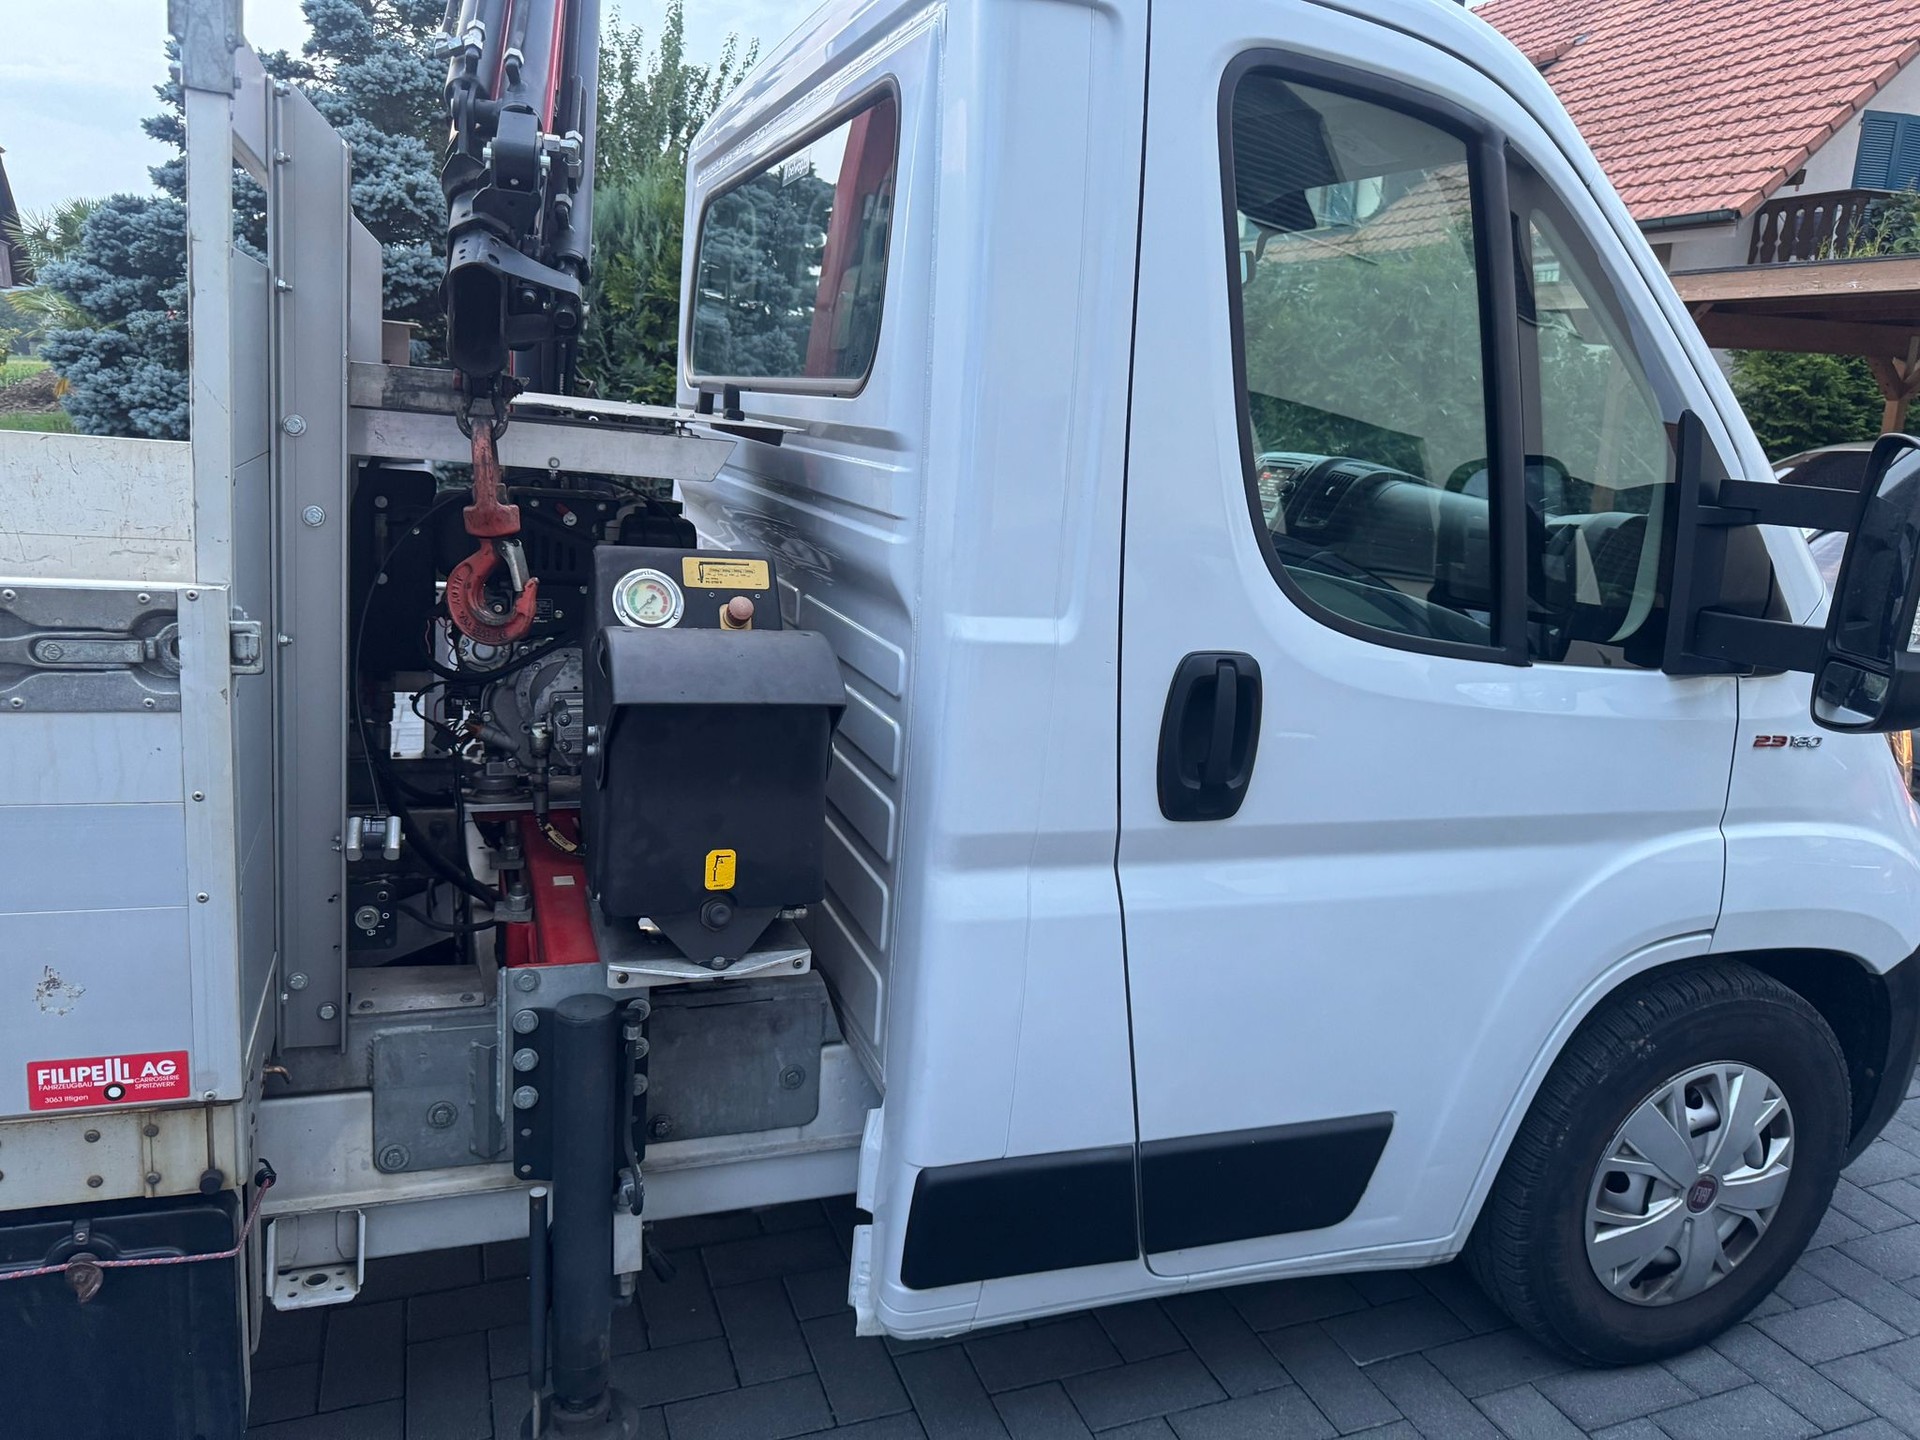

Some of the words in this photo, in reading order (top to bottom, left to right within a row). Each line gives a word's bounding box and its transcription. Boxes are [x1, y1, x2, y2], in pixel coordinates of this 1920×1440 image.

[140, 1059, 177, 1077] AG
[134, 1074, 180, 1084] CARROSSERIE
[38, 1081, 93, 1092] FAHRZEUGBAU
[135, 1081, 176, 1090] SPRITZWERK
[44, 1096, 63, 1104] 3063
[1693, 1186, 1712, 1203] FIAT
